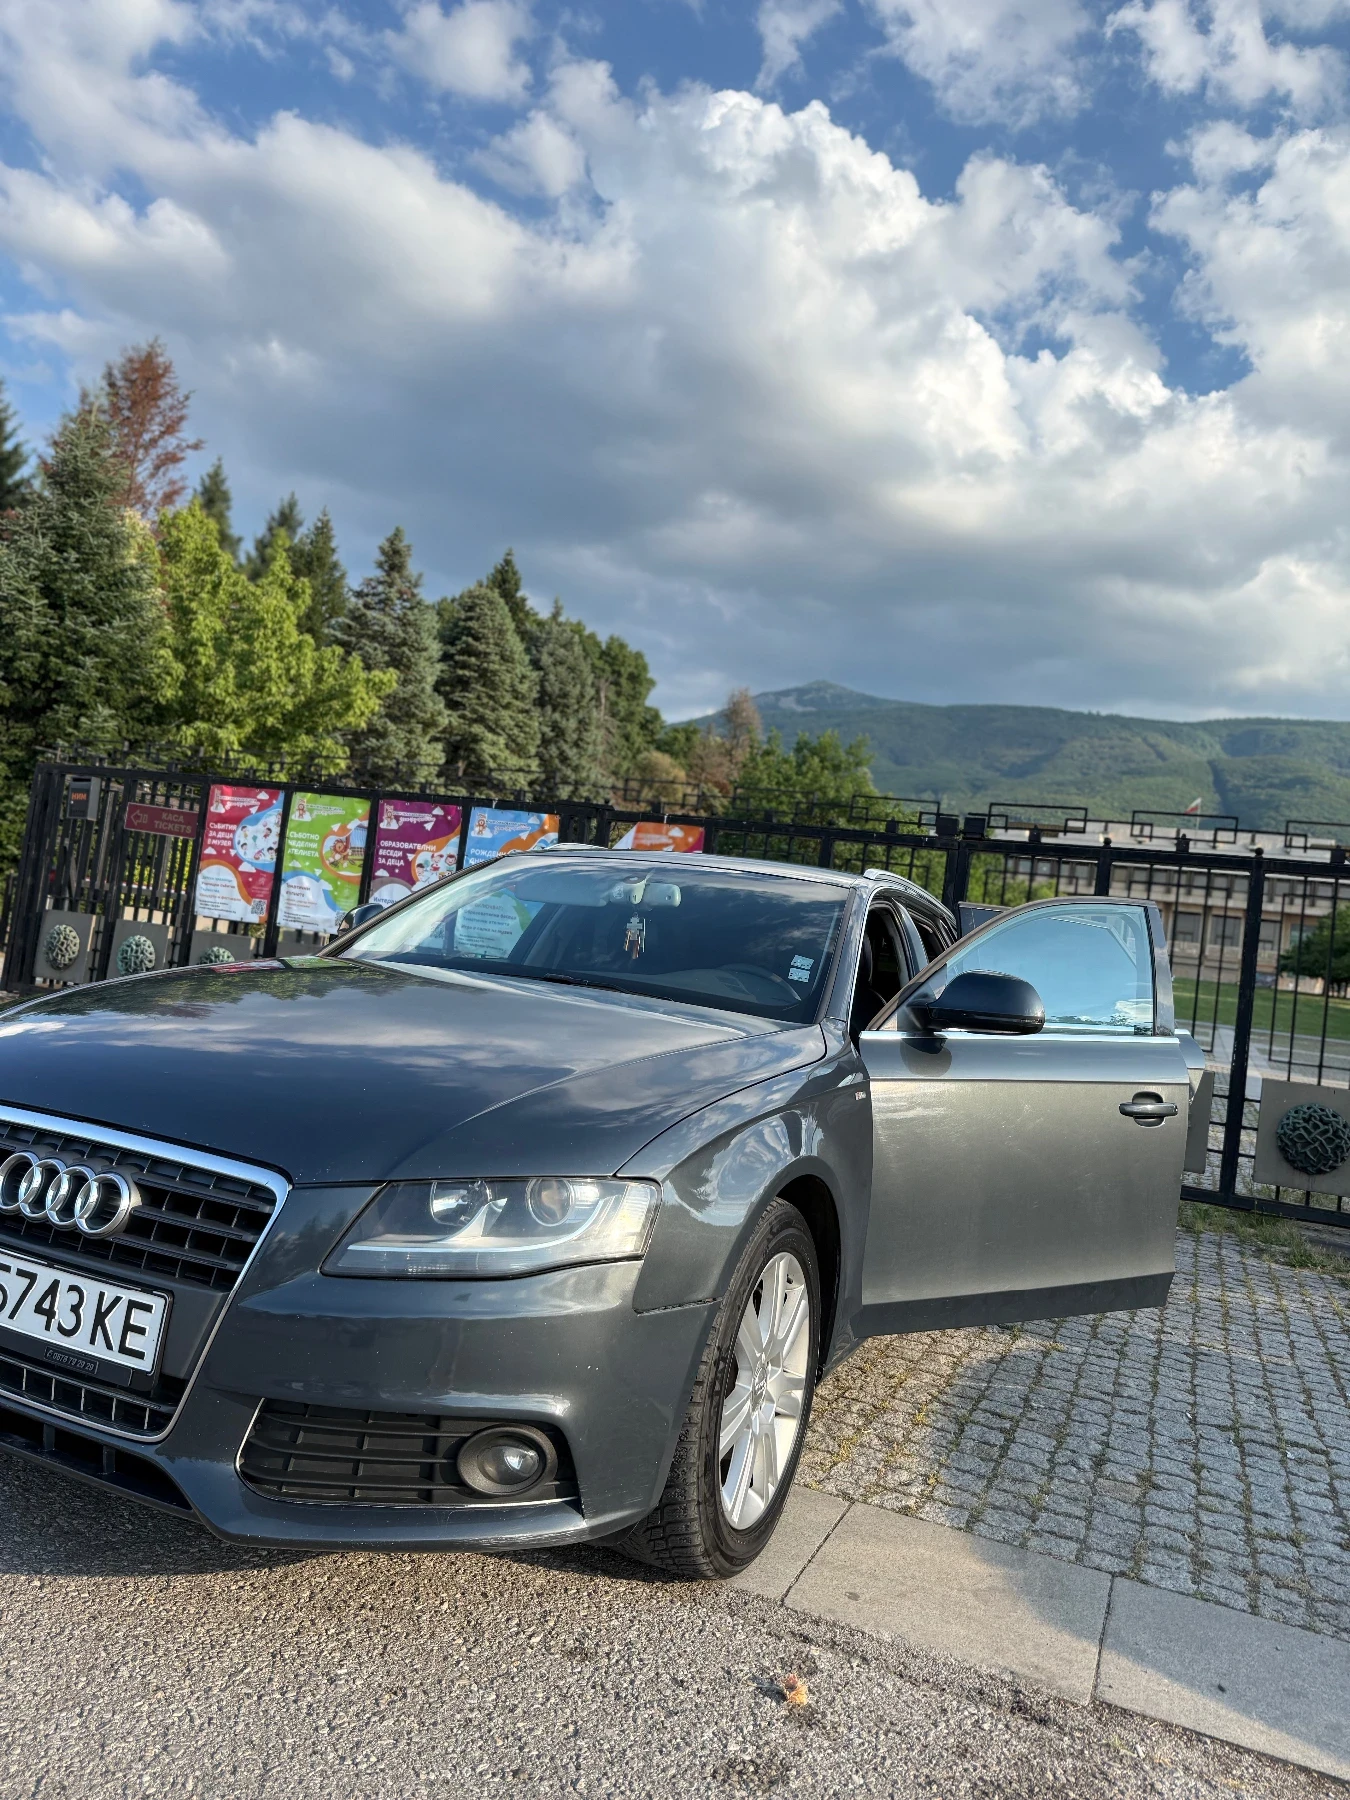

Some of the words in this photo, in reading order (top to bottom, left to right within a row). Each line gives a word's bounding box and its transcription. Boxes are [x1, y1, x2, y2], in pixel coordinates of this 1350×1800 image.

[162, 812, 184, 823] КАСА
[154, 820, 192, 834] TICKETS
[209, 822, 237, 831] СЪБИТИЯ
[217, 831, 234, 839] ДЕЦА
[289, 831, 320, 841] СЪБОТНО
[212, 839, 232, 847] МУЗЕЯ
[380, 840, 436, 851] ОБРАЗОВАТЕЛНИ
[287, 848, 319, 858] АТЕЛИЕТА
[378, 849, 403, 857] БЕСЕДИ
[387, 859, 405, 867] ДЕЦА
[90, 1291, 155, 1361] KE
